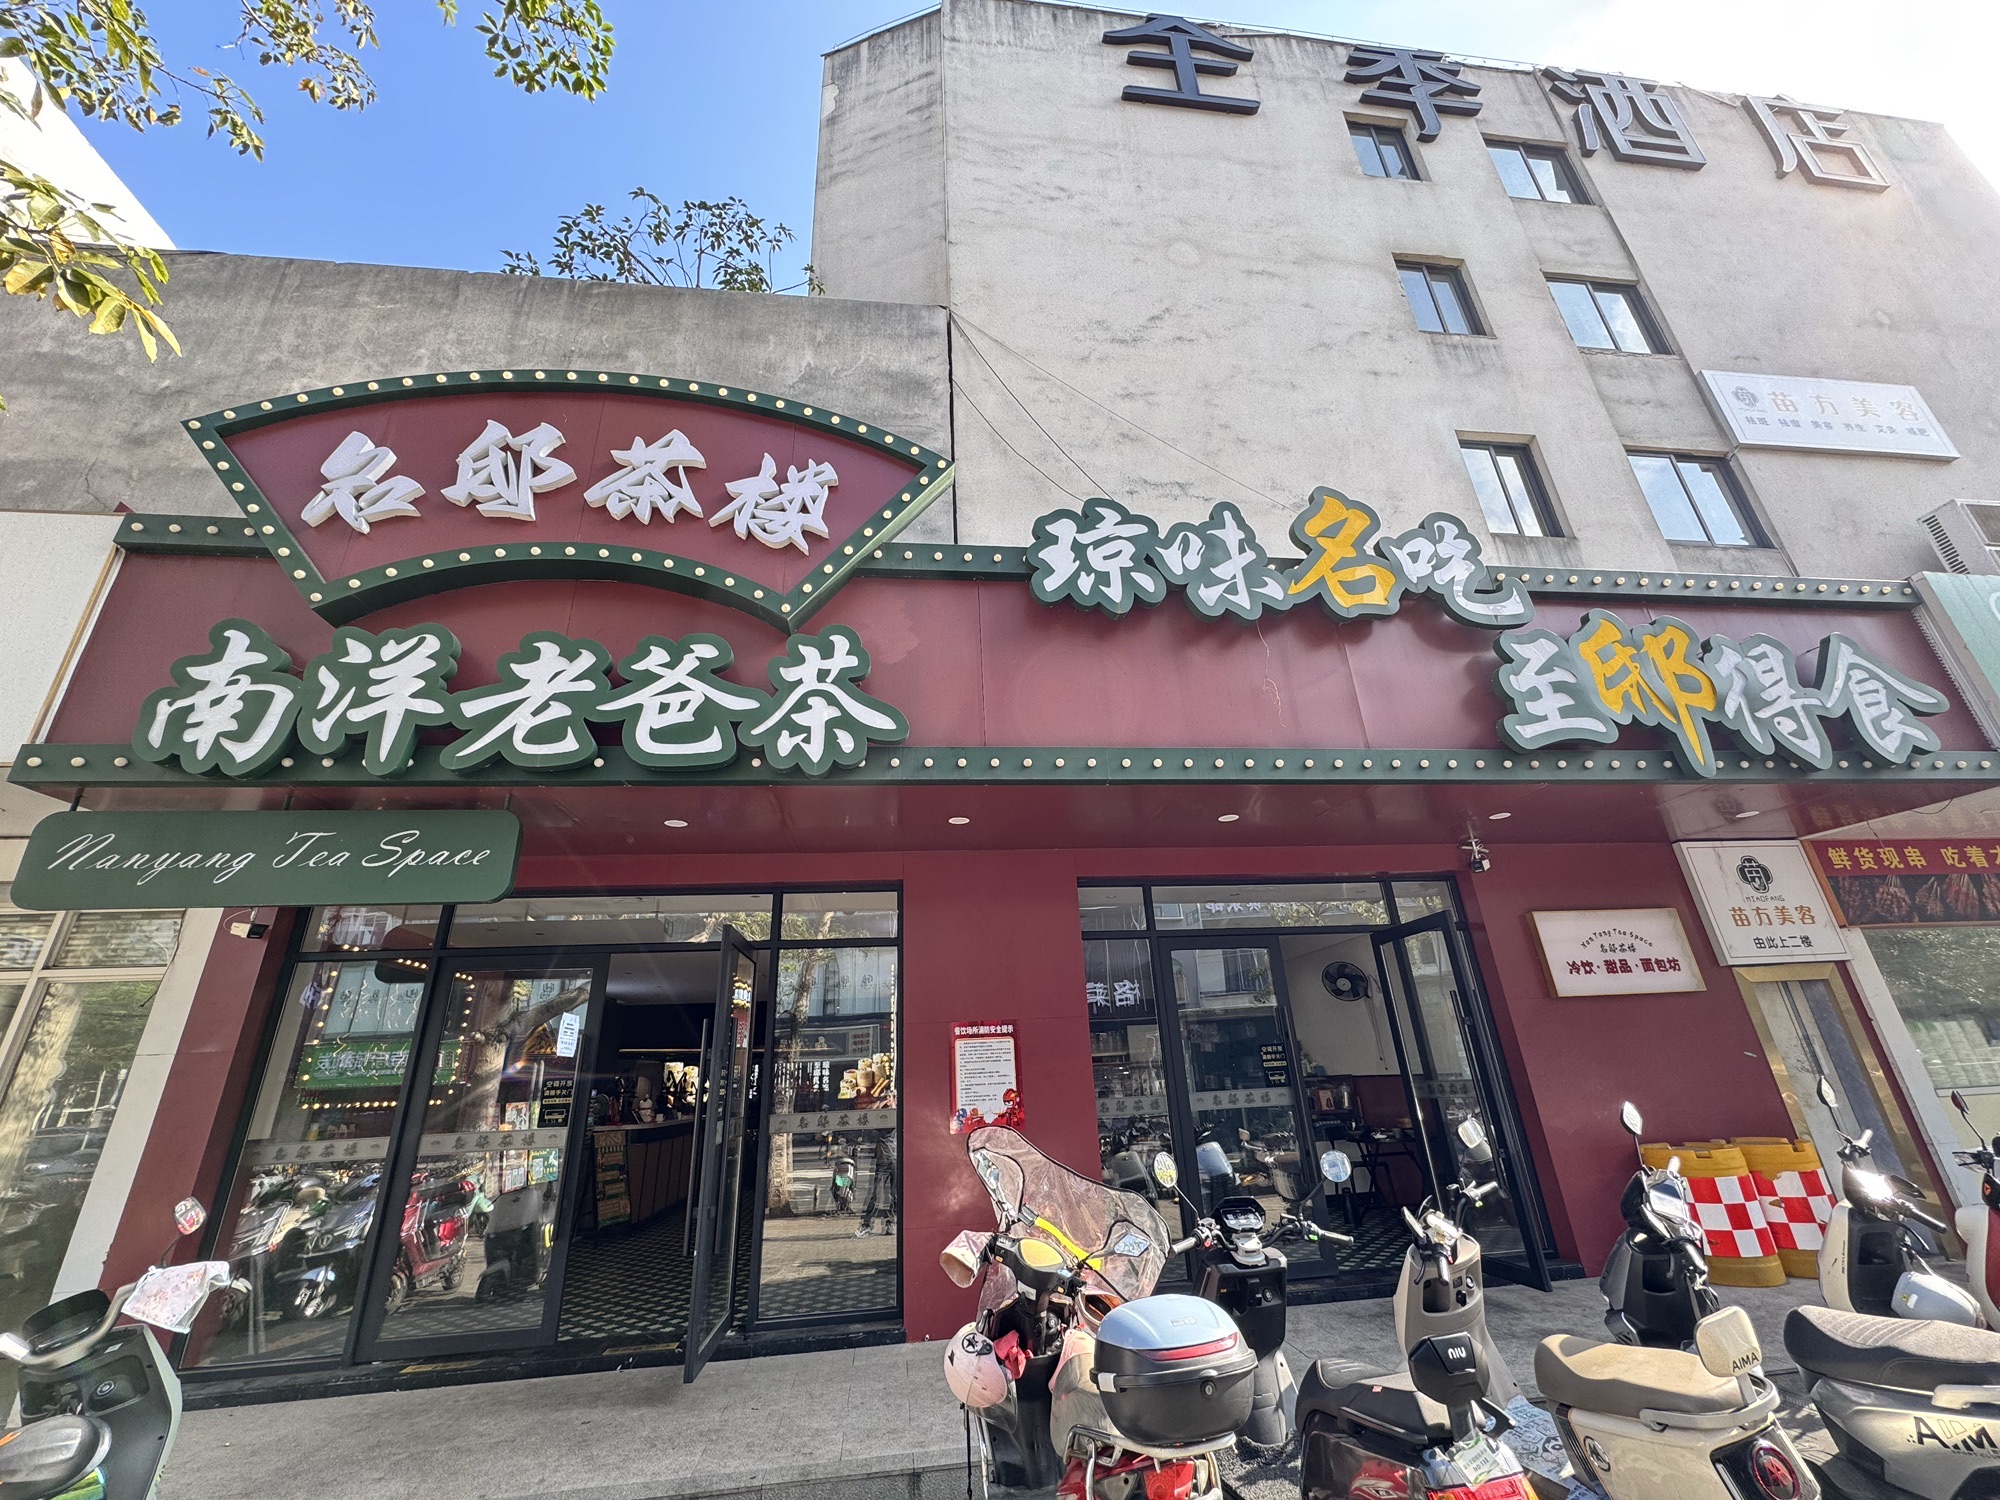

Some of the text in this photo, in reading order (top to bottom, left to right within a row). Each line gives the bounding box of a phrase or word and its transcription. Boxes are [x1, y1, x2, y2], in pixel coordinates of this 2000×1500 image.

[1102, 13, 1891, 193] 全季酒店
[1767, 391, 1920, 421] 苗方美容
[301, 419, 838, 555] 名邸茶楼
[1043, 495, 1525, 615] 琼味名吃
[148, 630, 897, 765] 南洋老爸茶
[1510, 618, 1939, 765] 至邸得食
[47, 829, 491, 886] Nanyang Tea Space
[1828, 847, 1928, 870] 鲜货现串
[1728, 905, 1816, 927] 苗方美容
[1745, 895, 1786, 903] MIAOFANG
[1753, 935, 1814, 949] 由此上二楼
[1732, 1352, 1759, 1372] AIMA
